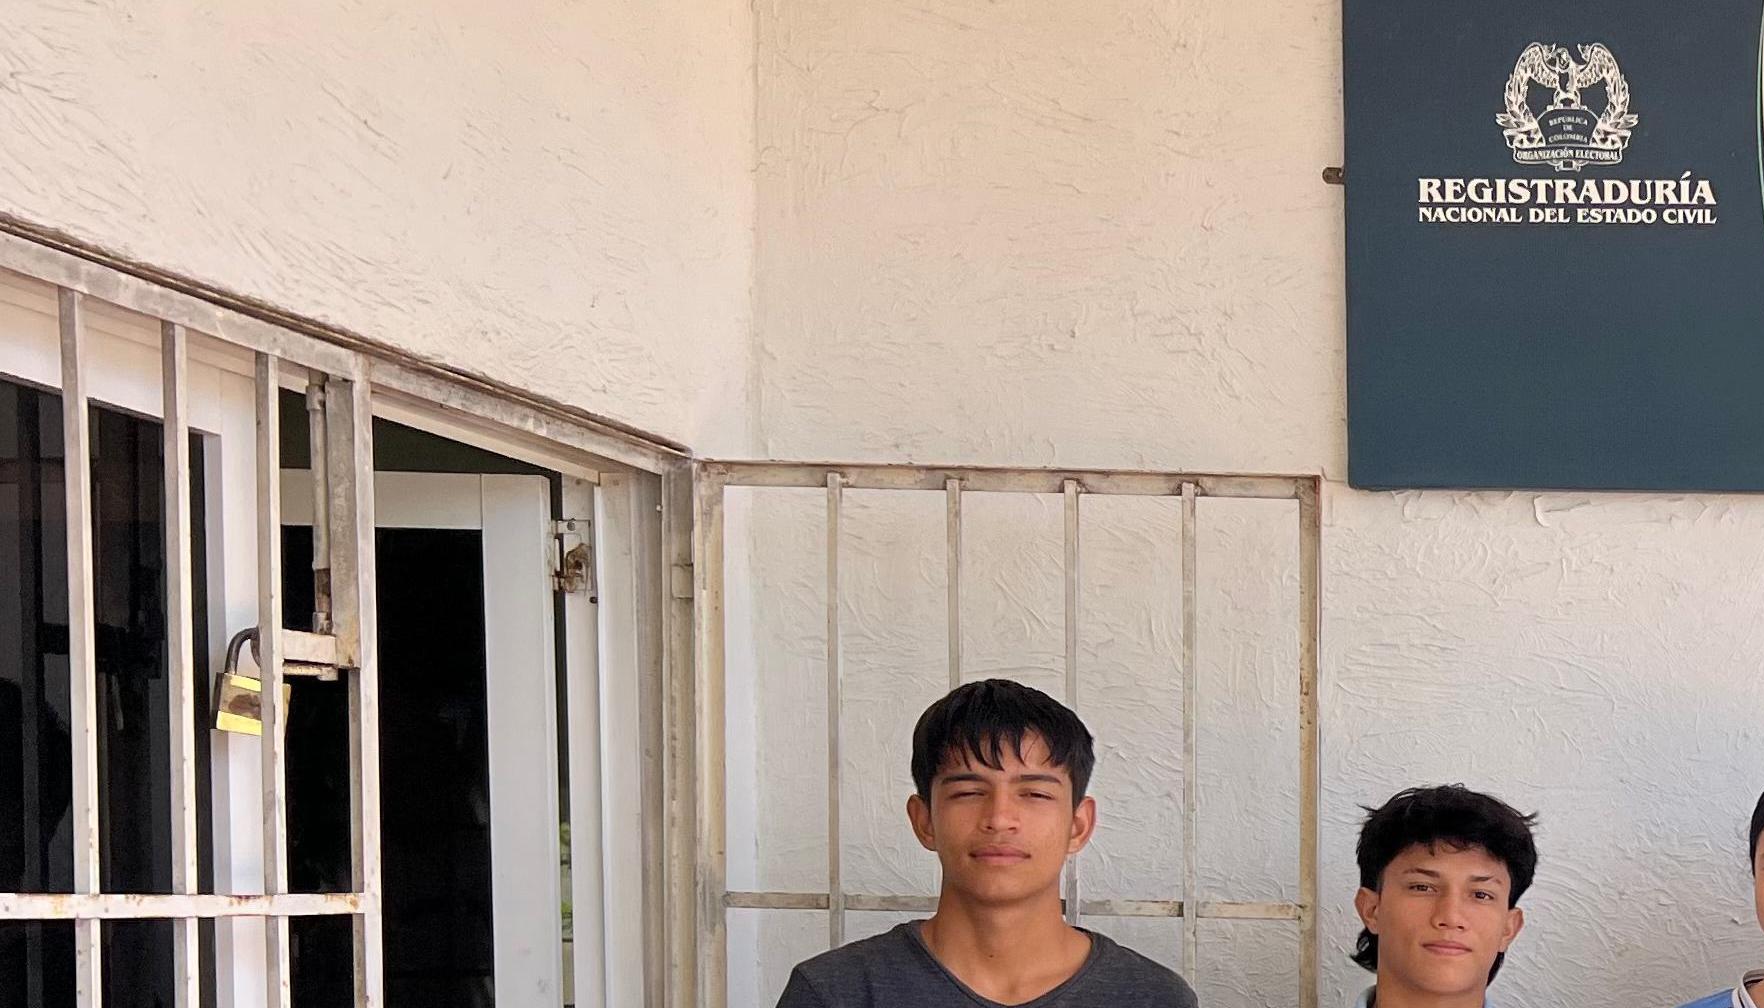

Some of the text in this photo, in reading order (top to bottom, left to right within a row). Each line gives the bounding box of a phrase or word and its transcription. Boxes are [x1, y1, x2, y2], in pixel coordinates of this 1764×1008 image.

[1418, 170, 1717, 206] REGISTRADURÍA
[1418, 206, 1717, 224] NACIONAL DEL ESTADO CIVIL
